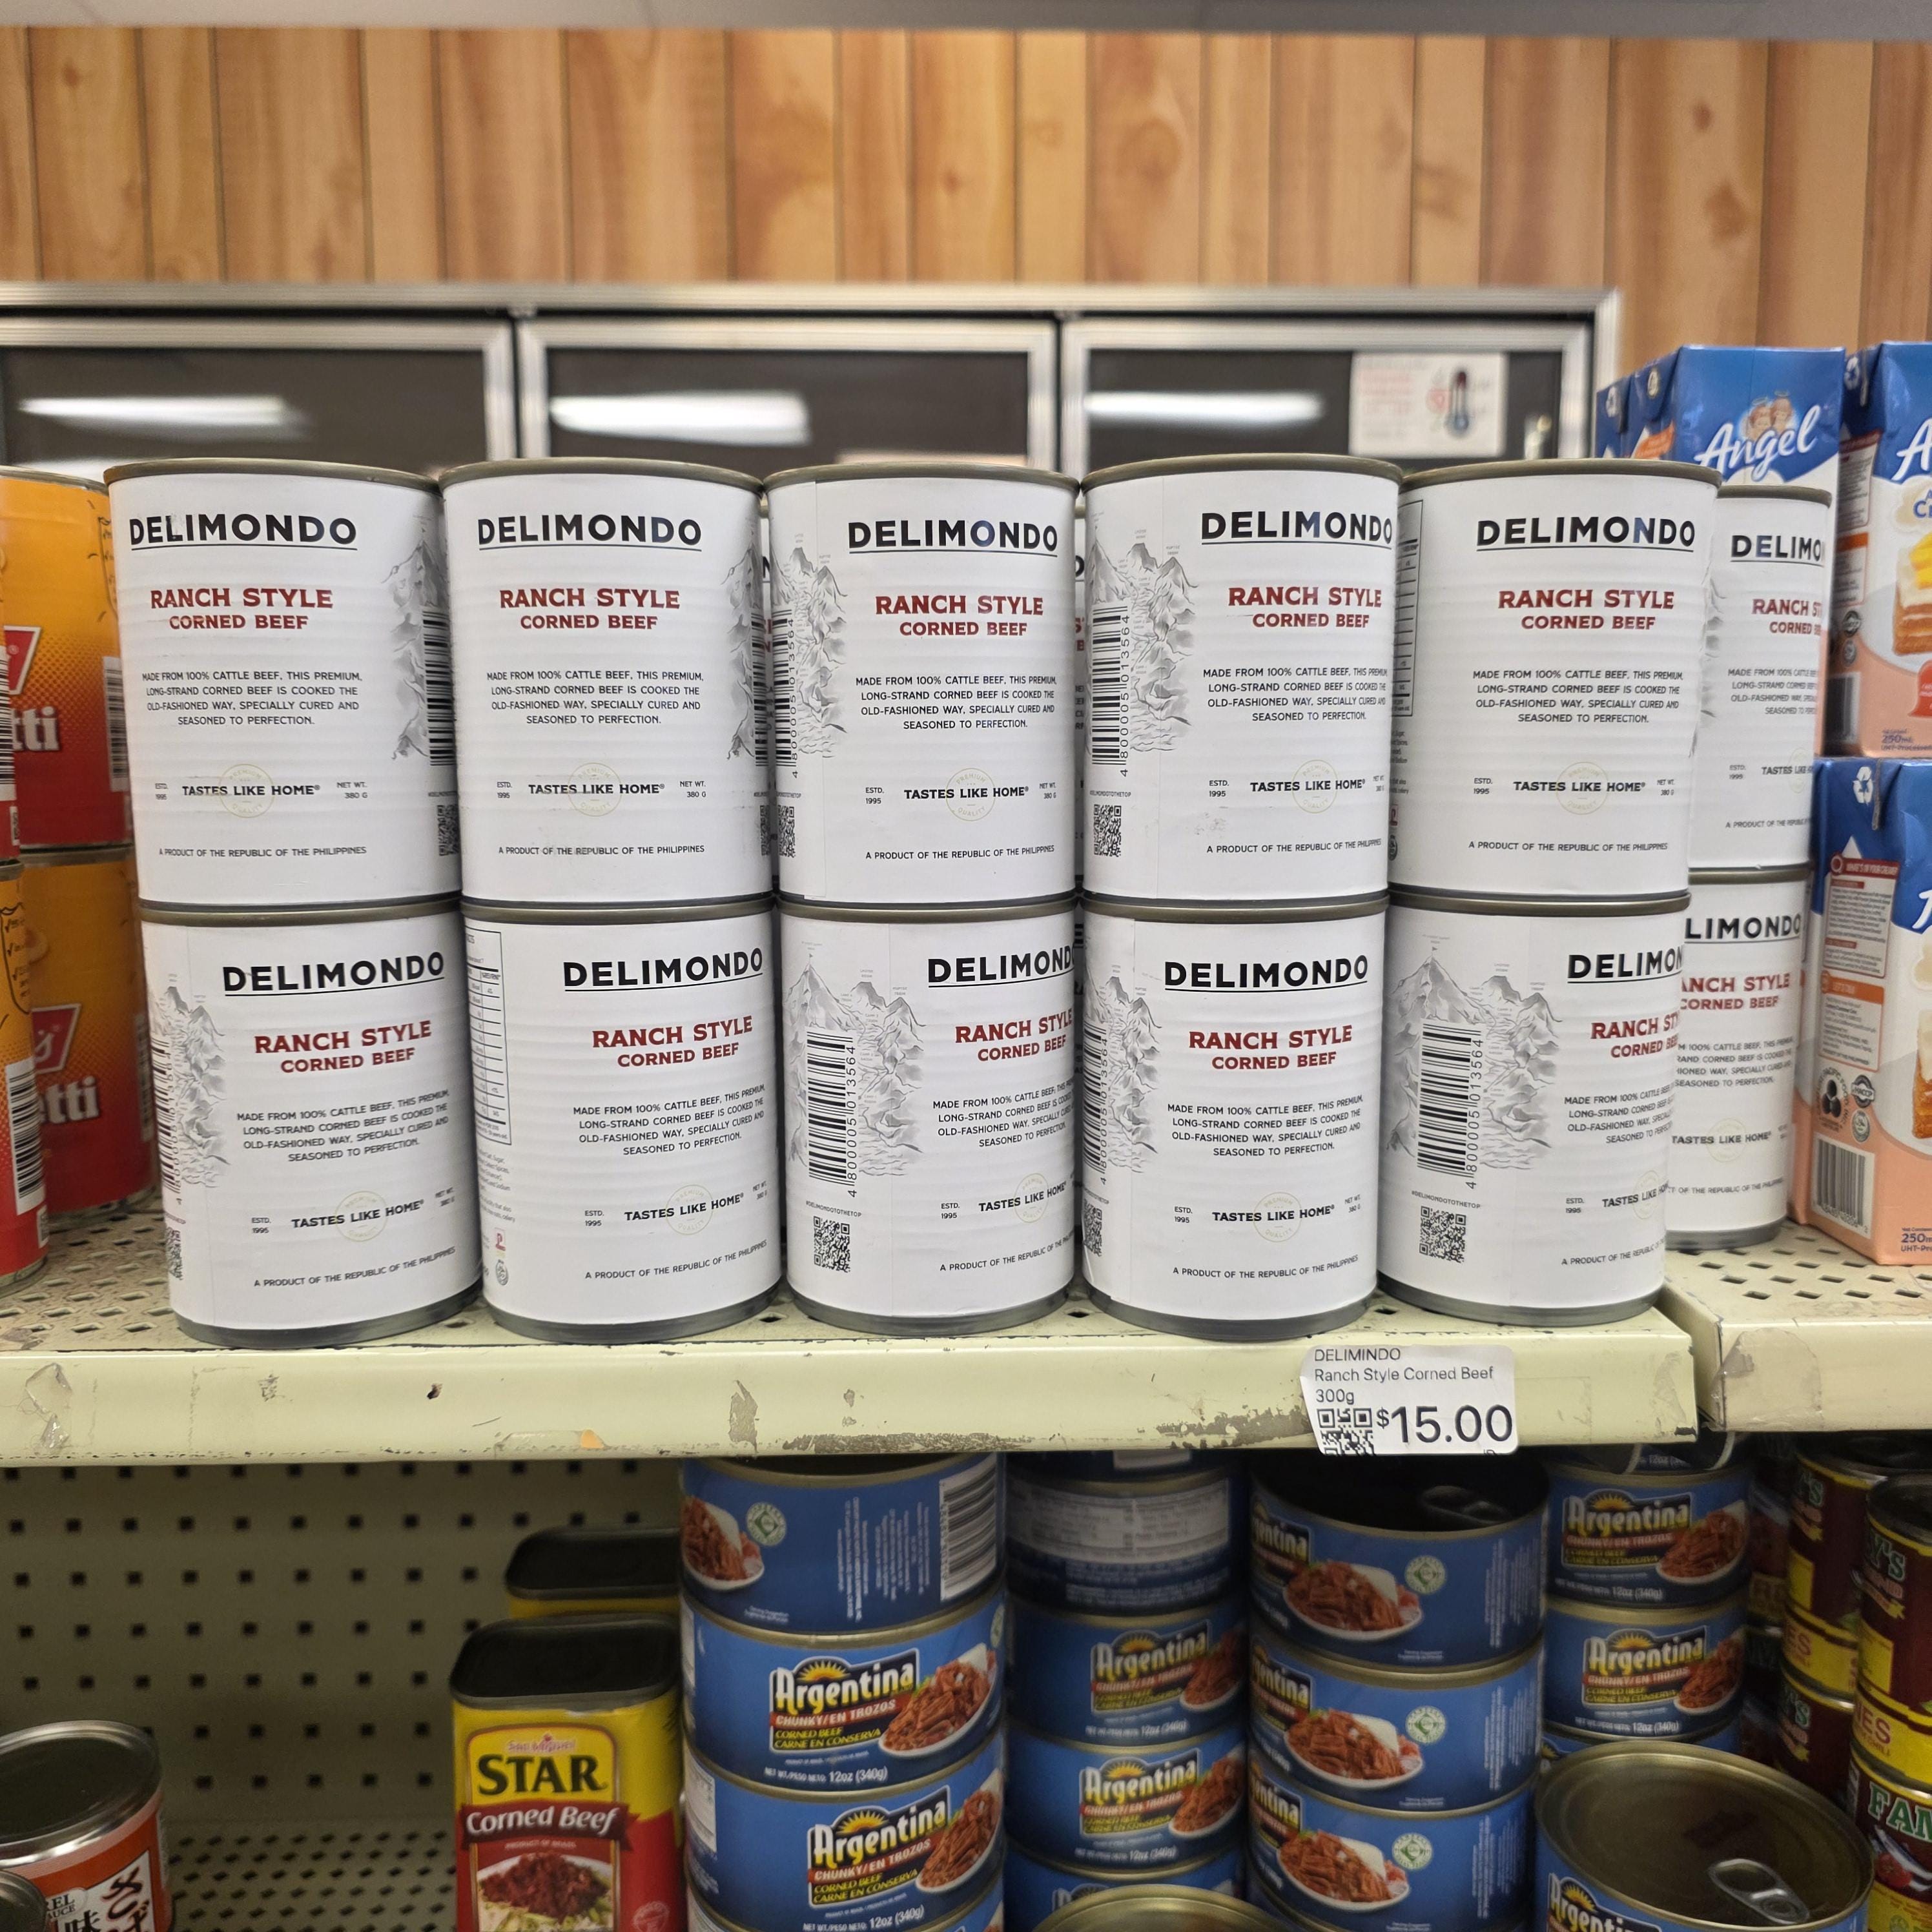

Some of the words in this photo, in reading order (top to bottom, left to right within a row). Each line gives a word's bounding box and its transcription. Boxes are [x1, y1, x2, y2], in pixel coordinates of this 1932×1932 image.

[1694, 406, 1822, 481] Angel
[130, 514, 356, 545] DELIMONDO
[478, 515, 701, 545] DELIMONDO
[848, 520, 1057, 551] DELIMONDO
[1202, 511, 1392, 544] DELIMONDO
[1477, 517, 1694, 546] DELIMONDO
[151, 588, 231, 608] RANCH
[243, 588, 333, 608] STYLE
[500, 588, 585, 608] RANCH
[597, 588, 680, 609] STYLE
[876, 595, 966, 614] RANCH
[978, 595, 1043, 615] STYLE
[1229, 586, 1318, 606] RANCH
[1329, 587, 1381, 608] STYLE
[1499, 590, 1593, 608] RANCH
[1605, 590, 1674, 609] STYLE
[1752, 599, 1809, 615] RANCH
[170, 615, 245, 630] CORNED
[255, 615, 308, 629] BEEF
[520, 615, 599, 629] CORNED
[608, 615, 657, 629] BEEF
[900, 622, 979, 635] CORNED
[987, 622, 1027, 635] BEEF
[1252, 613, 1329, 627] CORNED
[1336, 614, 1369, 628] BEEF
[1521, 616, 1604, 629] CORNED
[1612, 616, 1655, 630] BEEF
[1770, 622, 1812, 634] CORNED
[537, 671, 561, 679] 100%
[637, 671, 658, 679] THIS
[491, 686, 550, 695] LONG-STRAND
[641, 686, 680, 694] COOKED
[492, 701, 560, 710] OLD-FASHIONED
[648, 701, 679, 709] CURED
[683, 701, 701, 710] AND
[527, 715, 577, 724] SEASONED
[1762, 766, 1793, 775] TASTES
[182, 786, 227, 796] TASTES
[234, 786, 265, 796] LIKE
[528, 785, 577, 794] TASTES
[582, 785, 613, 794] LIKE
[904, 789, 954, 799] TASTES
[960, 788, 987, 798] LIKE
[1250, 782, 1300, 792] TASTES
[1306, 781, 1331, 790] LIKE
[1514, 782, 1565, 791] TASTES
[1572, 783, 1601, 792] LIKE
[657, 845, 704, 854] PHILIPPINES
[223, 952, 443, 991] DELIMONDO
[564, 948, 762, 986] DELIMONDO
[1165, 955, 1368, 987] DELIMONDO
[1744, 974, 1790, 991] STYLE
[1750, 997, 1779, 1008] BEEF
[254, 1031, 349, 1053] RANCH
[362, 1020, 431, 1046] STYLE
[592, 1026, 683, 1047] RANCH
[694, 1016, 752, 1041] STYLE
[956, 1020, 1035, 1045] RANCH
[1039, 1008, 1072, 1036] STYLE
[1591, 1018, 1658, 1039] RANCH
[1189, 1032, 1277, 1049] RANCH
[1289, 1025, 1352, 1048] STYLE
[618, 1050, 695, 1067] CORNED
[703, 1042, 739, 1060] BEEF
[978, 1043, 1040, 1061] CORNED
[1045, 1034, 1066, 1052] BEEF
[1611, 1040, 1663, 1058] CORNED
[281, 1055, 364, 1073] CORNED
[372, 1047, 415, 1065] BEEF
[1212, 1056, 1290, 1069] CORNED
[1297, 1051, 1336, 1067] BEEF
[1470, 1039, 1483, 1102] 013564
[1466, 1110, 1480, 1173] 800005
[1672, 1135, 1714, 1144] TASTES
[1719, 1135, 1743, 1144] LIKE
[291, 1215, 345, 1228] TASTES
[351, 1209, 380, 1222] LIKE
[624, 1208, 674, 1220] TASTES
[680, 1202, 706, 1215] LIKE
[1212, 1212, 1262, 1221] TASTES
[1268, 1211, 1295, 1220] LIKE
[1314, 1348, 1401, 1361] DELIMINDO
[1315, 1369, 1359, 1381] Ranch
[1364, 1368, 1399, 1384] Style
[1404, 1367, 1455, 1380] Corned
[1461, 1366, 1494, 1379] Beef
[1316, 1389, 1354, 1404] 300g
[1376, 1404, 1512, 1443] $15.00
[1568, 1495, 1689, 1537] Argentina
[1096, 1630, 1206, 1681] Argentina
[1589, 1637, 1703, 1676] Argentina
[775, 1662, 914, 1716] Argentina
[850, 1699, 896, 1719] TROZOS
[774, 1740, 807, 1749] CARNE
[810, 1738, 824, 1747] EN
[827, 1729, 881, 1745] CONSERVA
[775, 1728, 817, 1738] CORNED
[819, 1727, 843, 1736] BEEF
[478, 1754, 607, 1795] STAR
[829, 1771, 853, 1782] 12oz
[856, 1766, 888, 1782] (340g)
[1085, 1759, 1197, 1807] Argentina
[466, 1806, 555, 1833] Corned
[558, 1806, 620, 1836] Beef
[814, 1800, 946, 1869] Argentina
